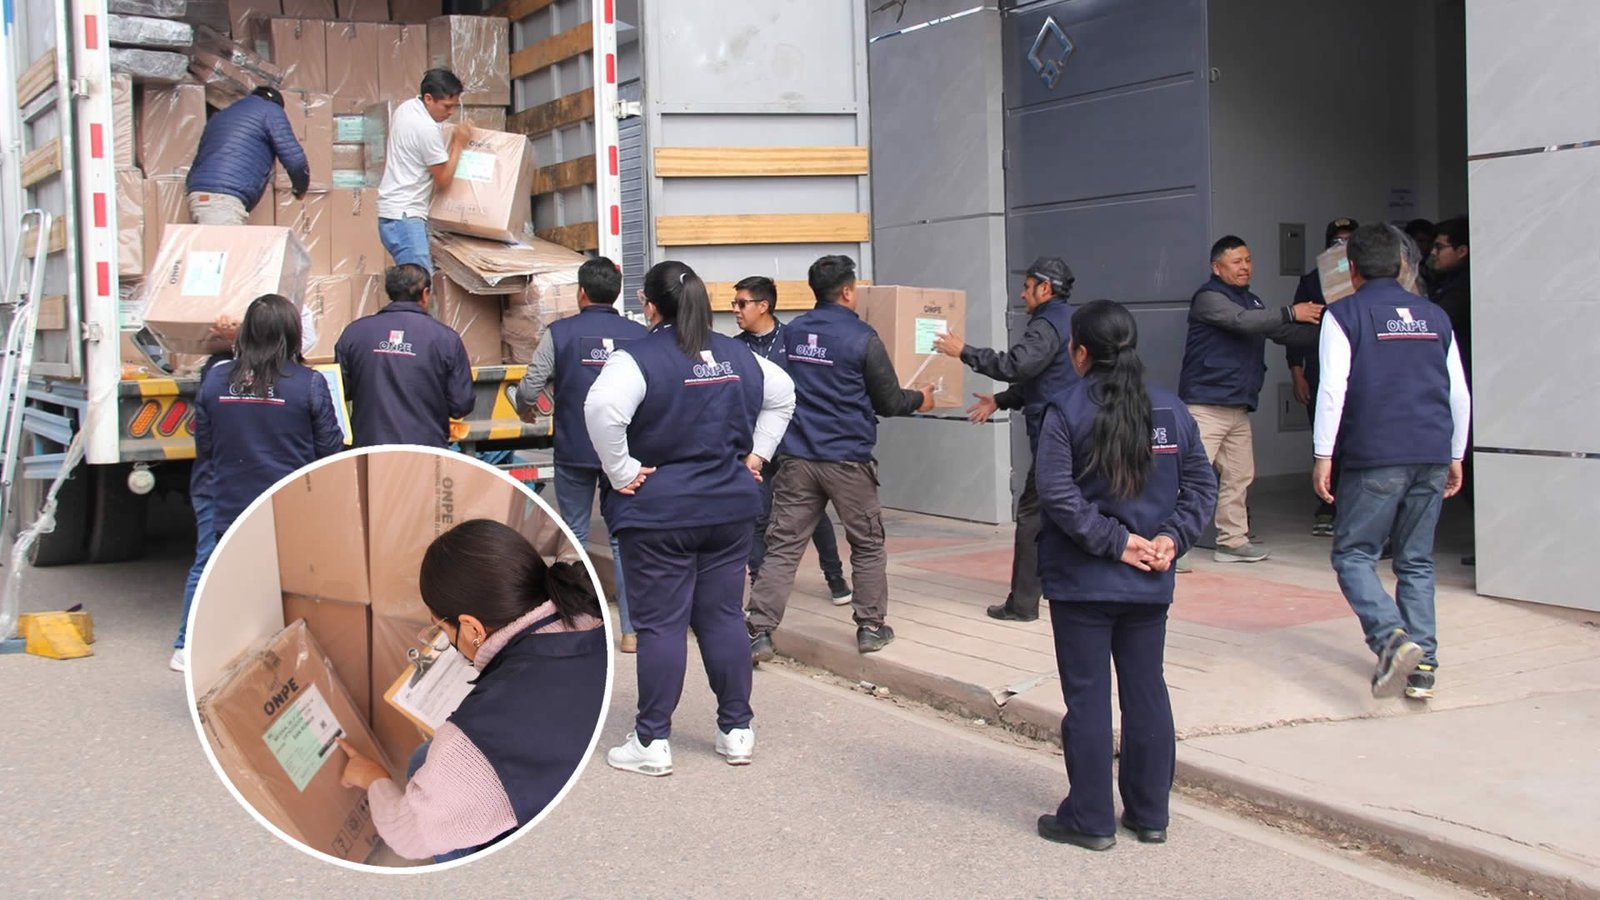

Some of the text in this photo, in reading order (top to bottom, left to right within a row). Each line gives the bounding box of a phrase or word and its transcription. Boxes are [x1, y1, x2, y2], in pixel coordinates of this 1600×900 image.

[1386, 319, 1428, 332] ONPE
[379, 340, 412, 352] ONPE
[795, 343, 827, 358] ONPE
[692, 361, 734, 378] ONPE
[442, 476, 454, 524] ONPE
[263, 677, 299, 717] ONPE
